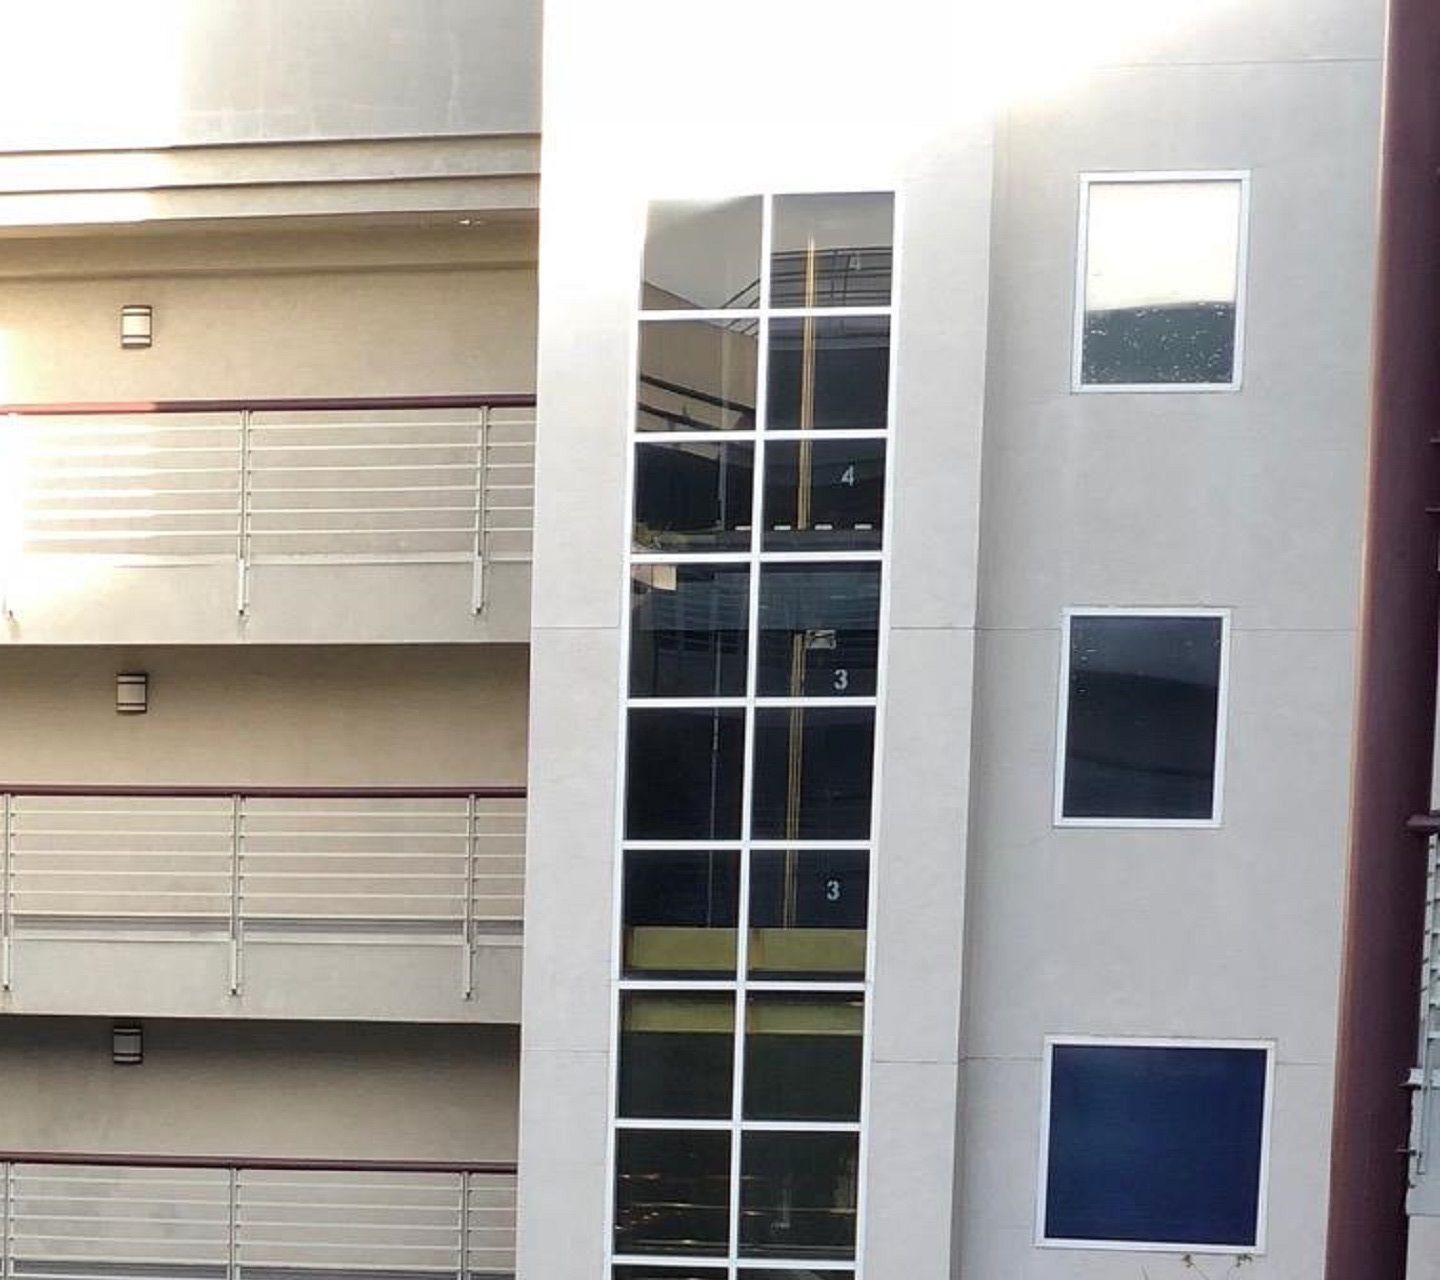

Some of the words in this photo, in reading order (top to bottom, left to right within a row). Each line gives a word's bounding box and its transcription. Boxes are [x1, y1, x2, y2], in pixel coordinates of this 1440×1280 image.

[841, 464, 854, 486] 4
[833, 669, 848, 690] 3
[826, 880, 840, 900] 3
